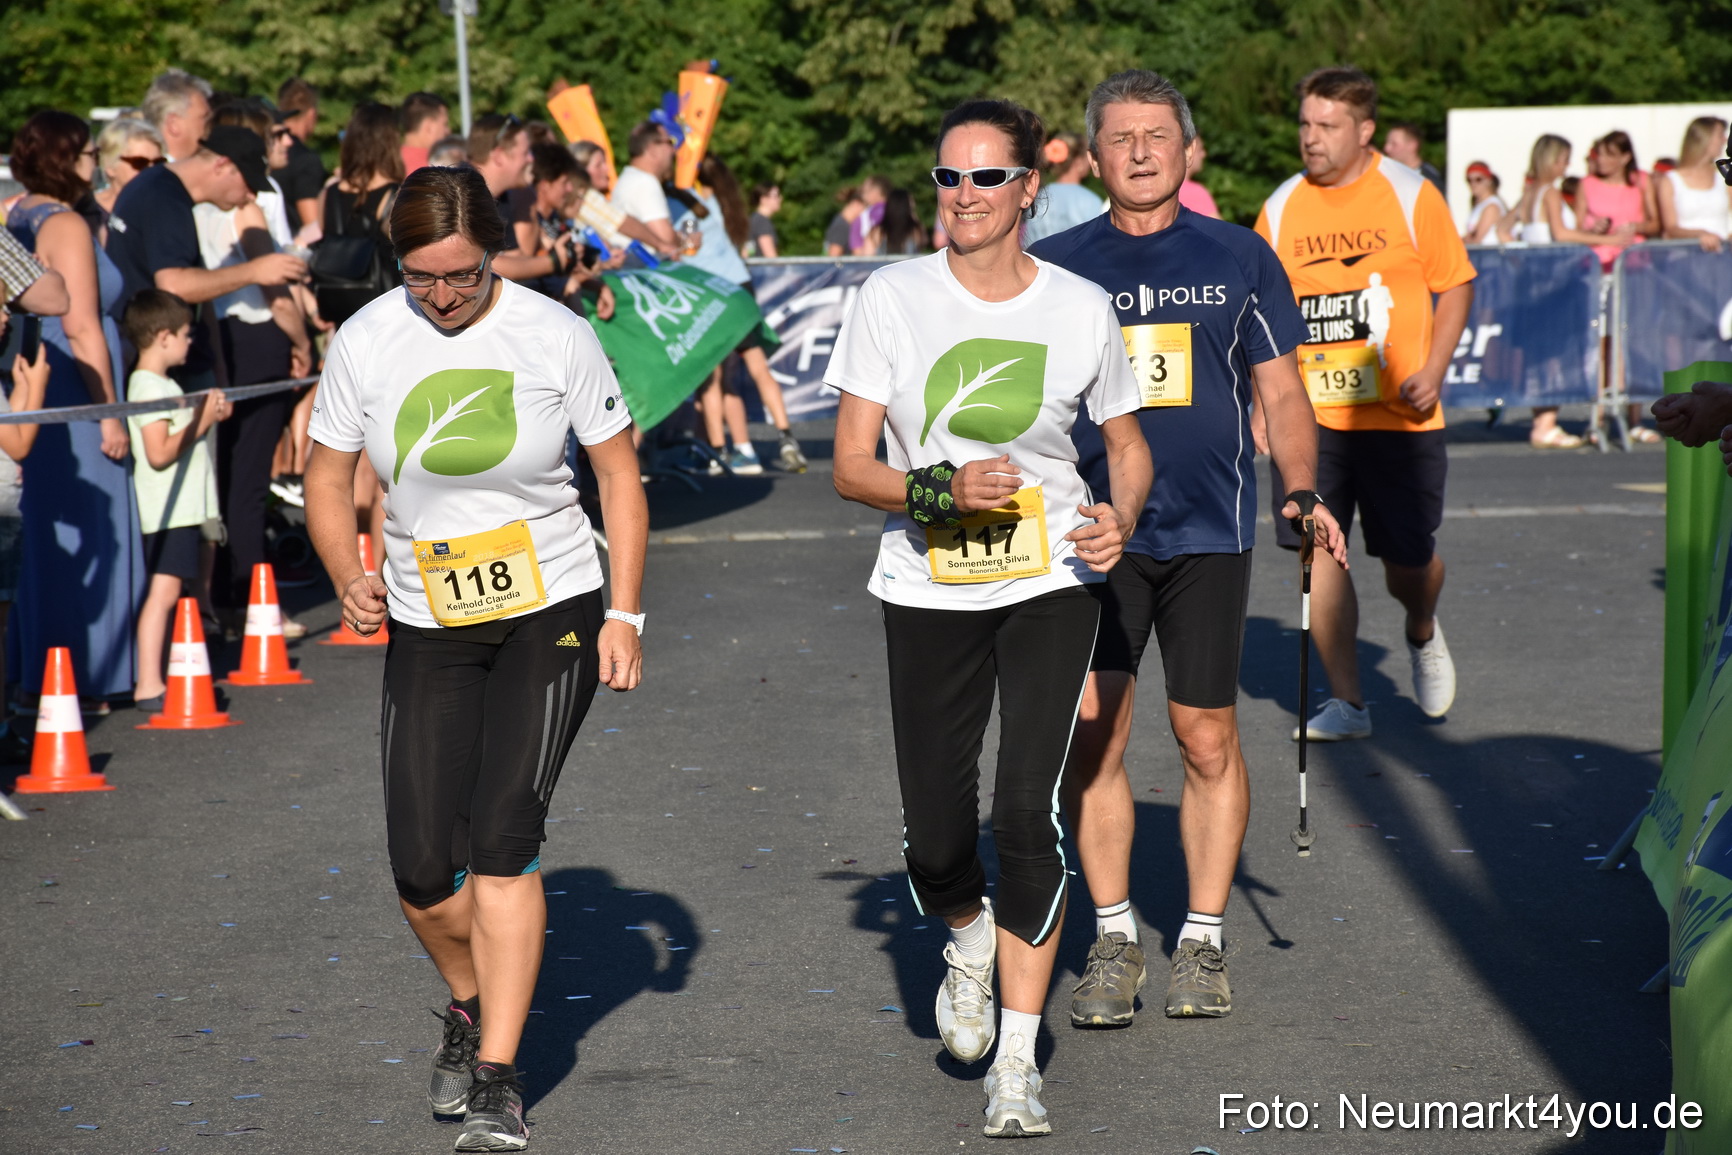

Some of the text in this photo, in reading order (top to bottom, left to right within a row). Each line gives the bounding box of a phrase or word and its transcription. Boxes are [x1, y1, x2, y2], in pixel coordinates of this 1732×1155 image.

[1294, 237, 1304, 257] BIT
[1306, 229, 1387, 255] WINGS
[1159, 285, 1226, 307] POLES
[1301, 294, 1354, 319] #LÄUFT
[1323, 318, 1354, 342] UNS
[1320, 368, 1362, 390] 193
[953, 522, 1018, 558] 117
[947, 554, 1030, 569] Sonnenberg Silvia
[444, 560, 513, 600] 118
[446, 590, 521, 611] Keilhold Claudia
[464, 605, 495, 616] Bionorica
[495, 603, 505, 611] SE
